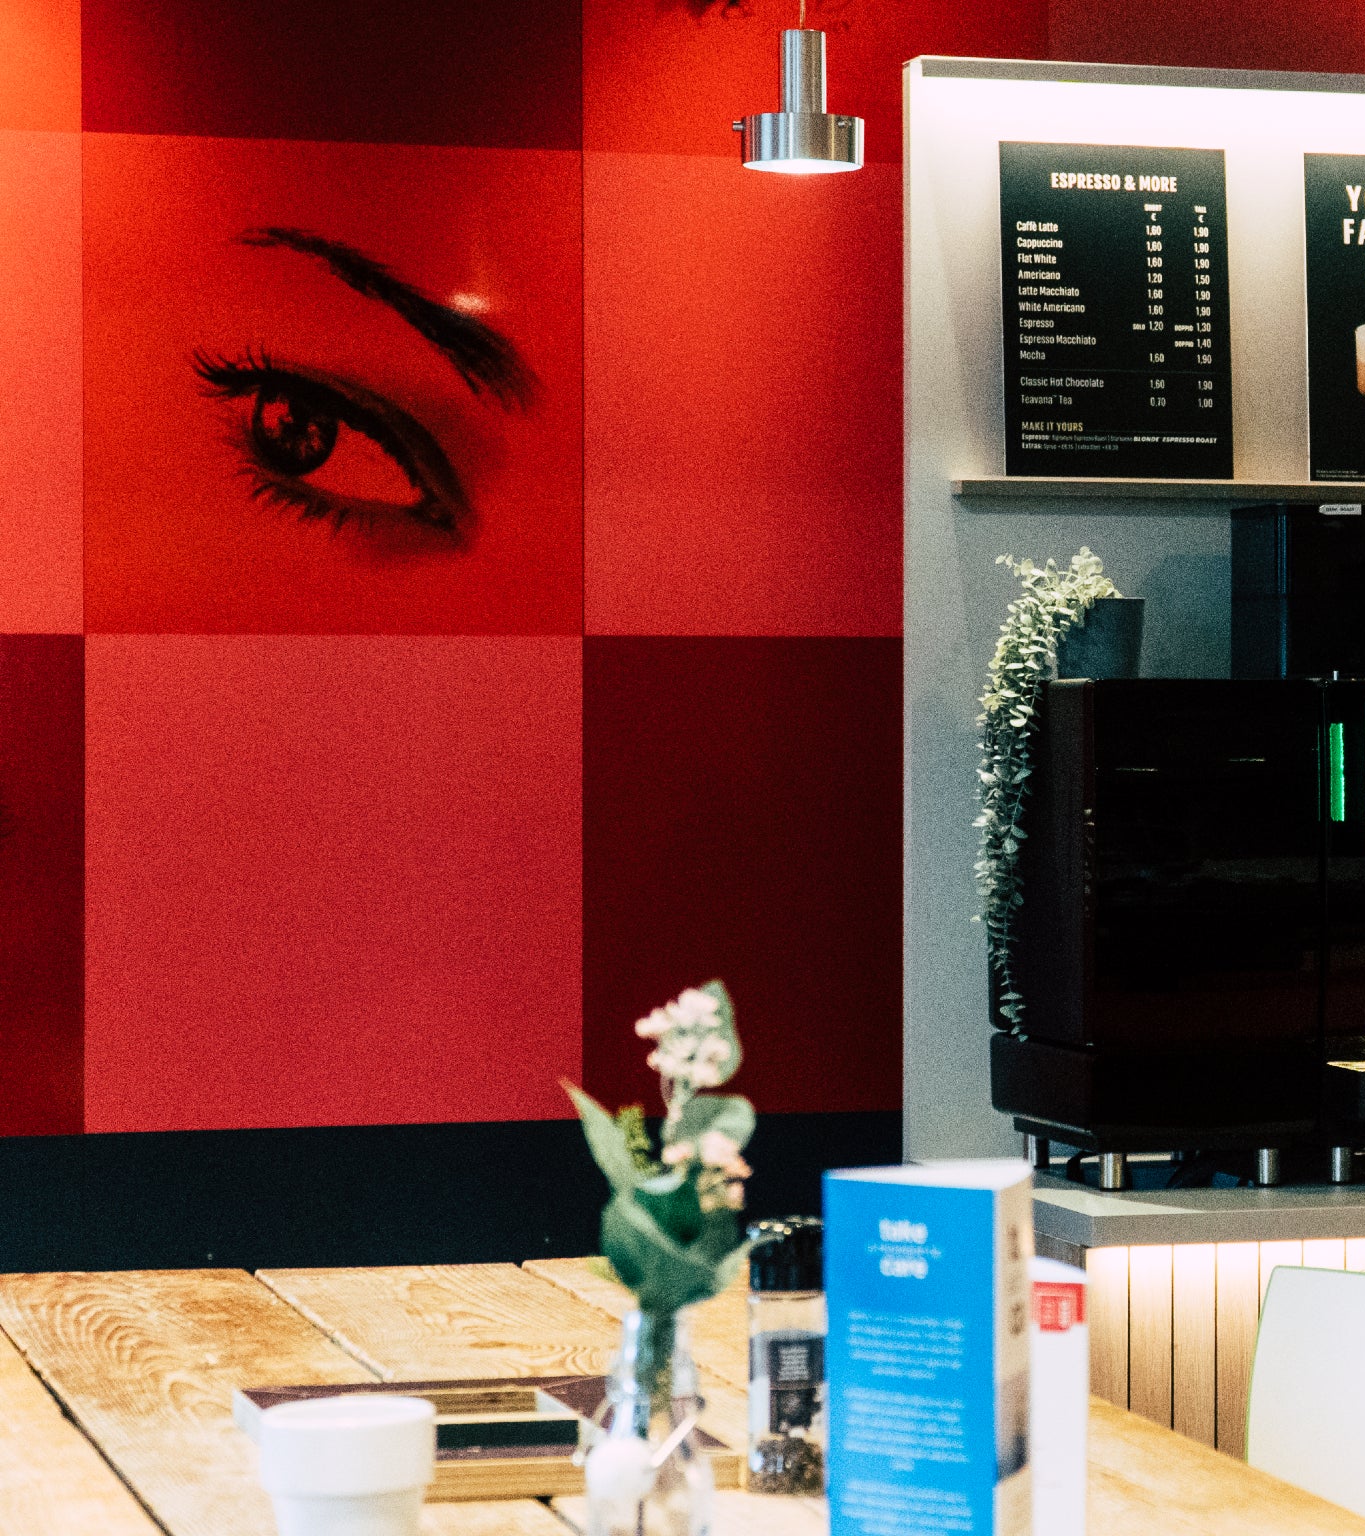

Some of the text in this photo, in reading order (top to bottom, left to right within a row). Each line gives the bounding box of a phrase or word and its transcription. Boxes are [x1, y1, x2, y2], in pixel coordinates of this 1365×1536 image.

[1051, 173, 1177, 192] ESPRESSO & MORE
[1017, 221, 1037, 233] Caffè
[1039, 222, 1058, 233] Latte
[1017, 237, 1063, 249] Cappuccino
[1018, 254, 1032, 263] Flat
[1034, 254, 1056, 264] White
[1018, 270, 1060, 280] Americano
[1018, 286, 1038, 296] Latte
[1039, 287, 1079, 297] Macchiato
[1019, 302, 1042, 312] White
[1043, 303, 1085, 313] Americano
[1020, 318, 1054, 329] Espresso
[1020, 335, 1055, 345] Espresso
[1056, 335, 1096, 345] Macchiato
[1020, 350, 1046, 360] Mocha
[1020, 377, 1049, 387] Classic
[1050, 377, 1064, 387] Hot
[1065, 377, 1104, 388] Chocolate
[1059, 395, 1072, 405] Tea
[1022, 422, 1083, 431] MAKE IT YOURS
